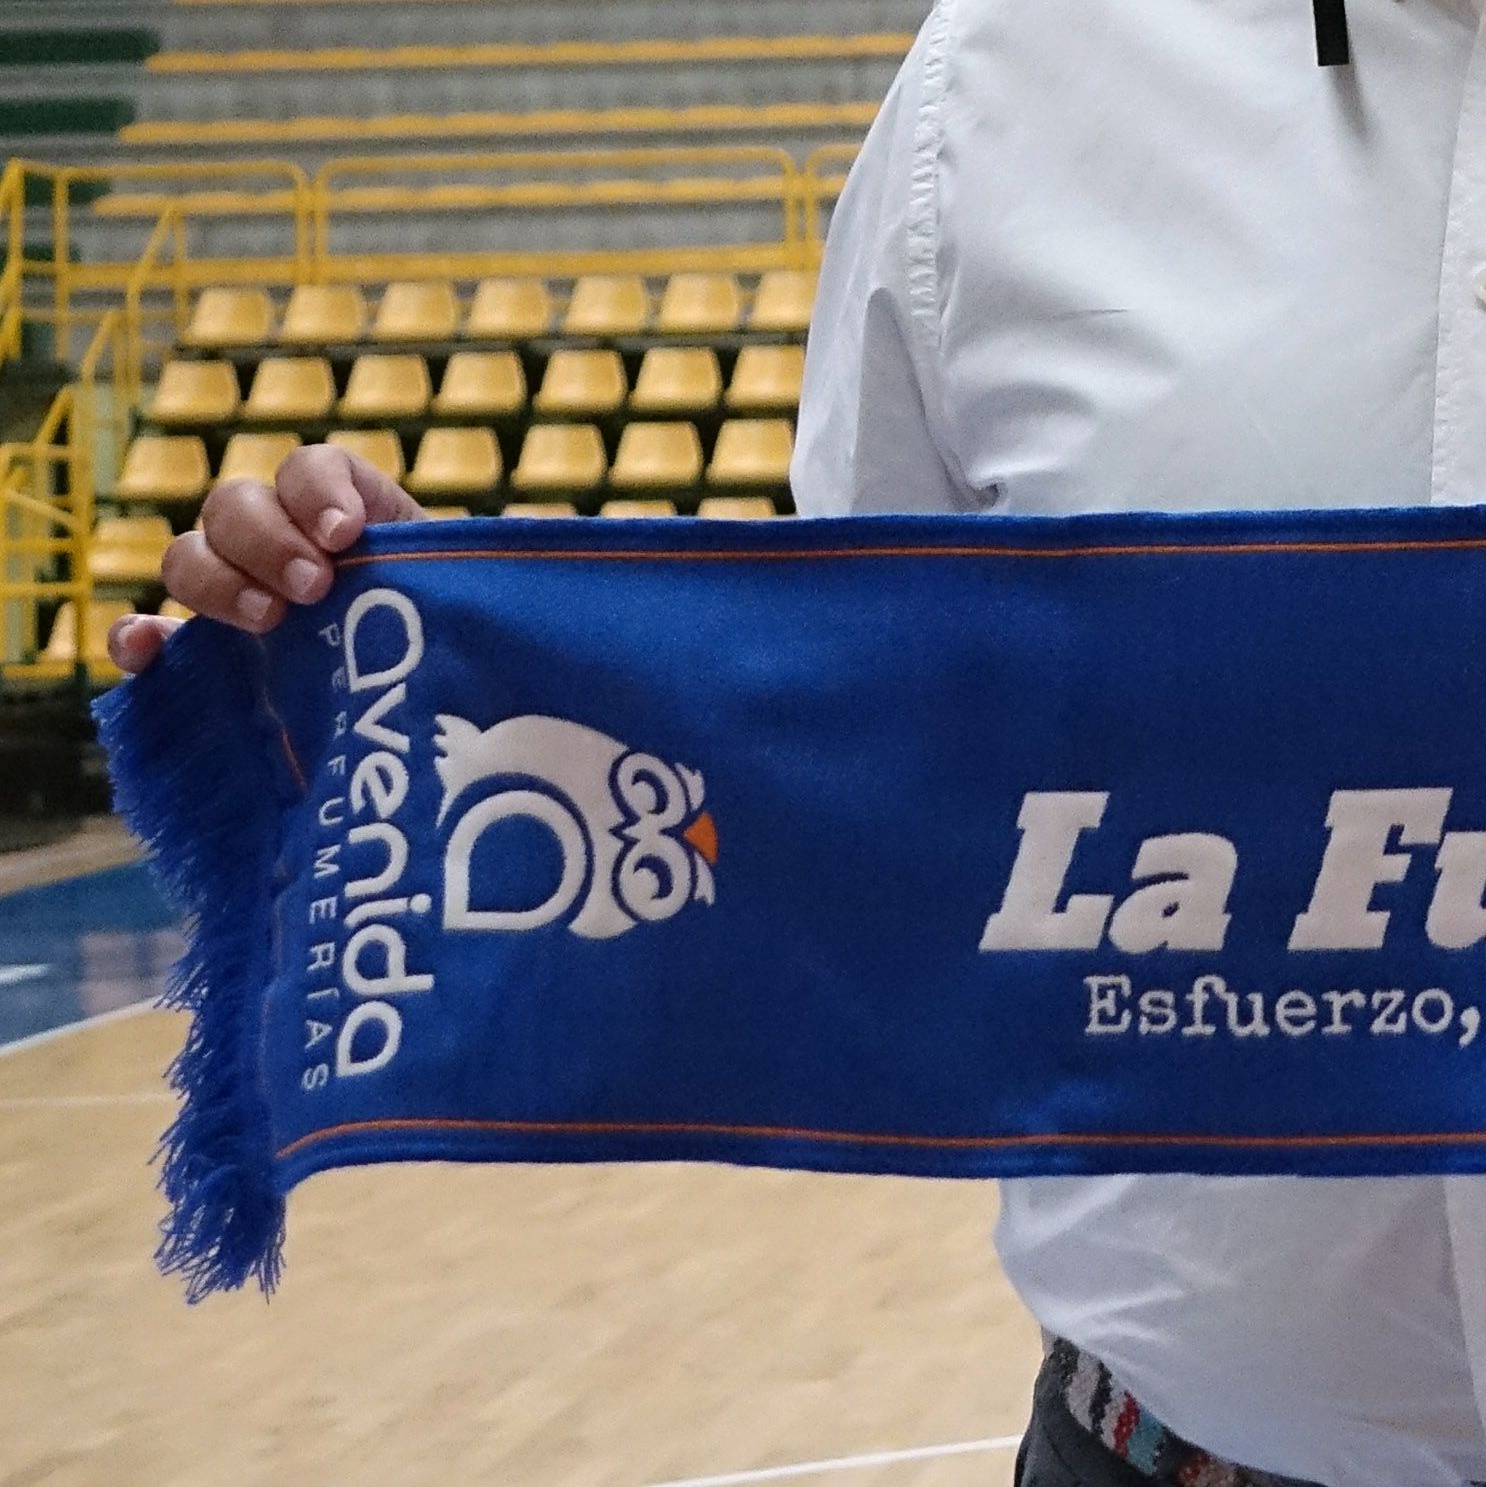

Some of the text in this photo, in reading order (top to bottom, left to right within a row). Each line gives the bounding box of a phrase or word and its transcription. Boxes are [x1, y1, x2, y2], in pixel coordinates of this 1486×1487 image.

[335, 587, 435, 1077] avenida
[978, 790, 1238, 954] La
[1082, 973, 1482, 1048] Esfuerzo,
